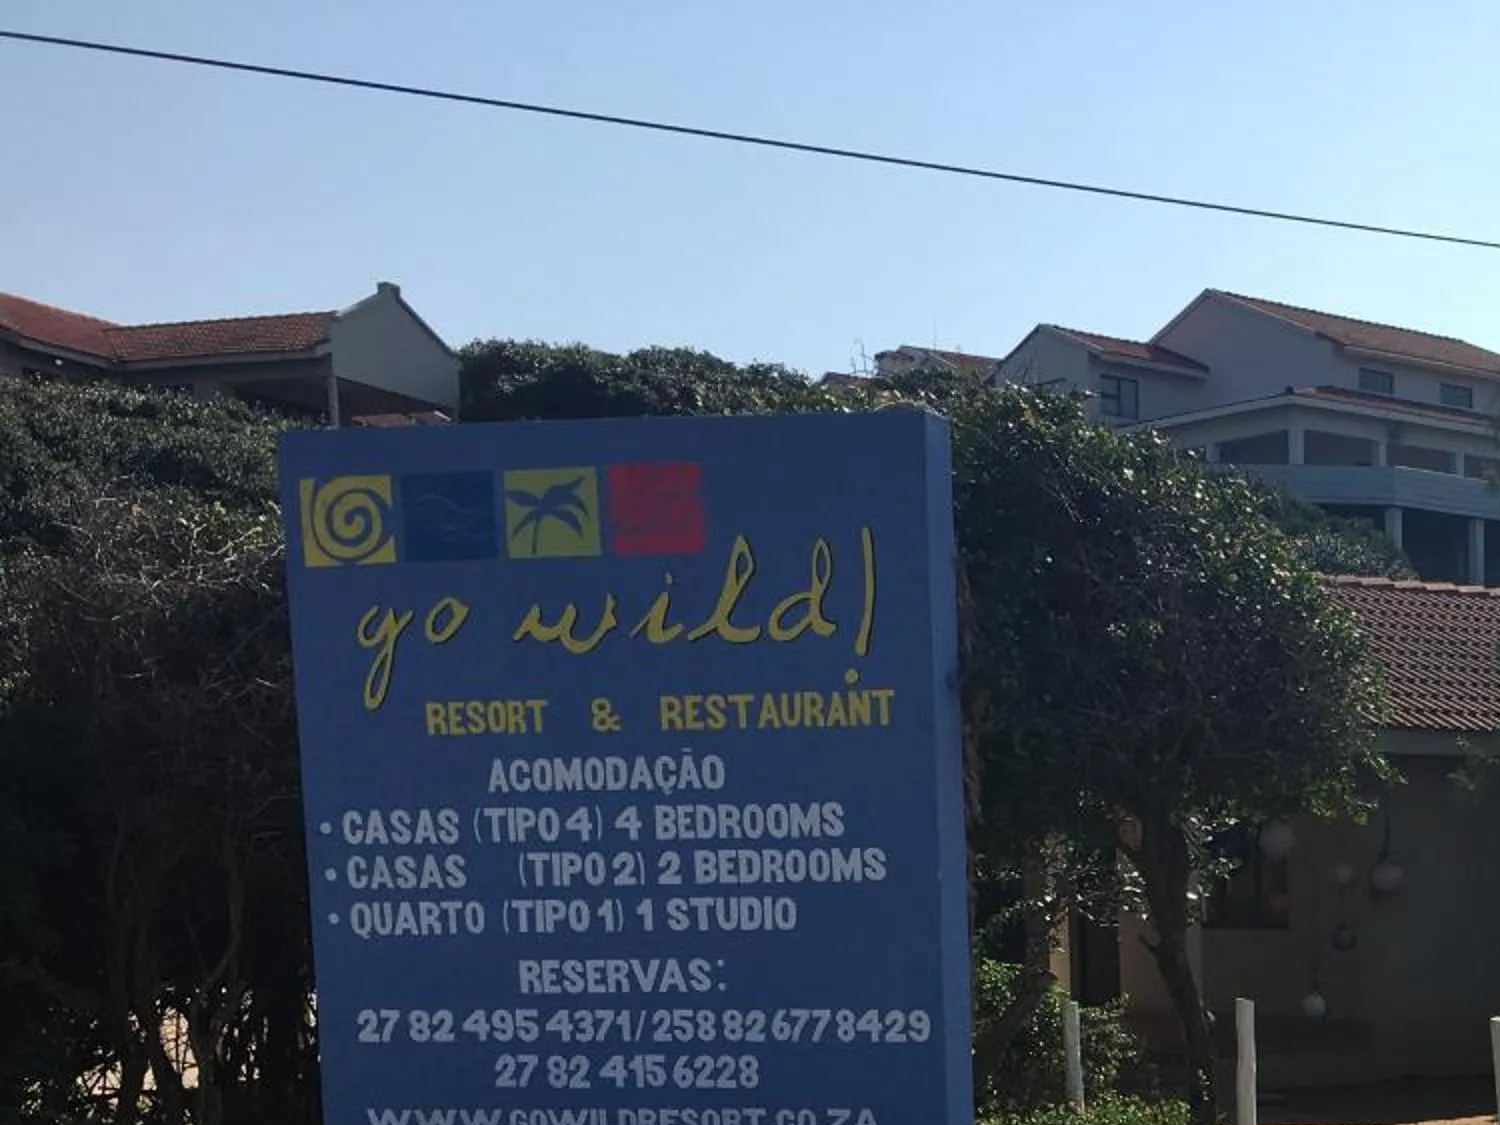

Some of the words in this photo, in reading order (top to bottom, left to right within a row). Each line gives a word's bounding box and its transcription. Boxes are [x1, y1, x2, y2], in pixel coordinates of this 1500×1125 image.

[356, 596, 470, 711] go
[513, 527, 875, 684] wild!
[425, 699, 548, 735] RESORT
[591, 697, 620, 731] &
[660, 689, 895, 731] RESTAURANT
[487, 748, 726, 795] ACOMODAÇÃO
[342, 809, 459, 845] CASAS
[615, 806, 642, 841] 4
[655, 801, 846, 841] BEDROOMS
[347, 855, 468, 889] CASAS
[658, 854, 683, 886] 2
[694, 847, 887, 885] BEDROOMS
[350, 900, 485, 938] QUARTO
[637, 900, 654, 931] 1
[667, 898, 796, 931] STUDIO
[519, 958, 728, 995] RESERVAS:
[356, 1010, 401, 1044] 27
[409, 1010, 454, 1043] 82
[462, 1009, 539, 1043] 495
[723, 1009, 768, 1043] 82
[772, 1009, 829, 1043] 677
[837, 1009, 931, 1043] 8429
[494, 1056, 537, 1089] 27
[547, 1055, 591, 1089] 82
[600, 1055, 668, 1089] 415
[673, 1055, 760, 1089] 6228
